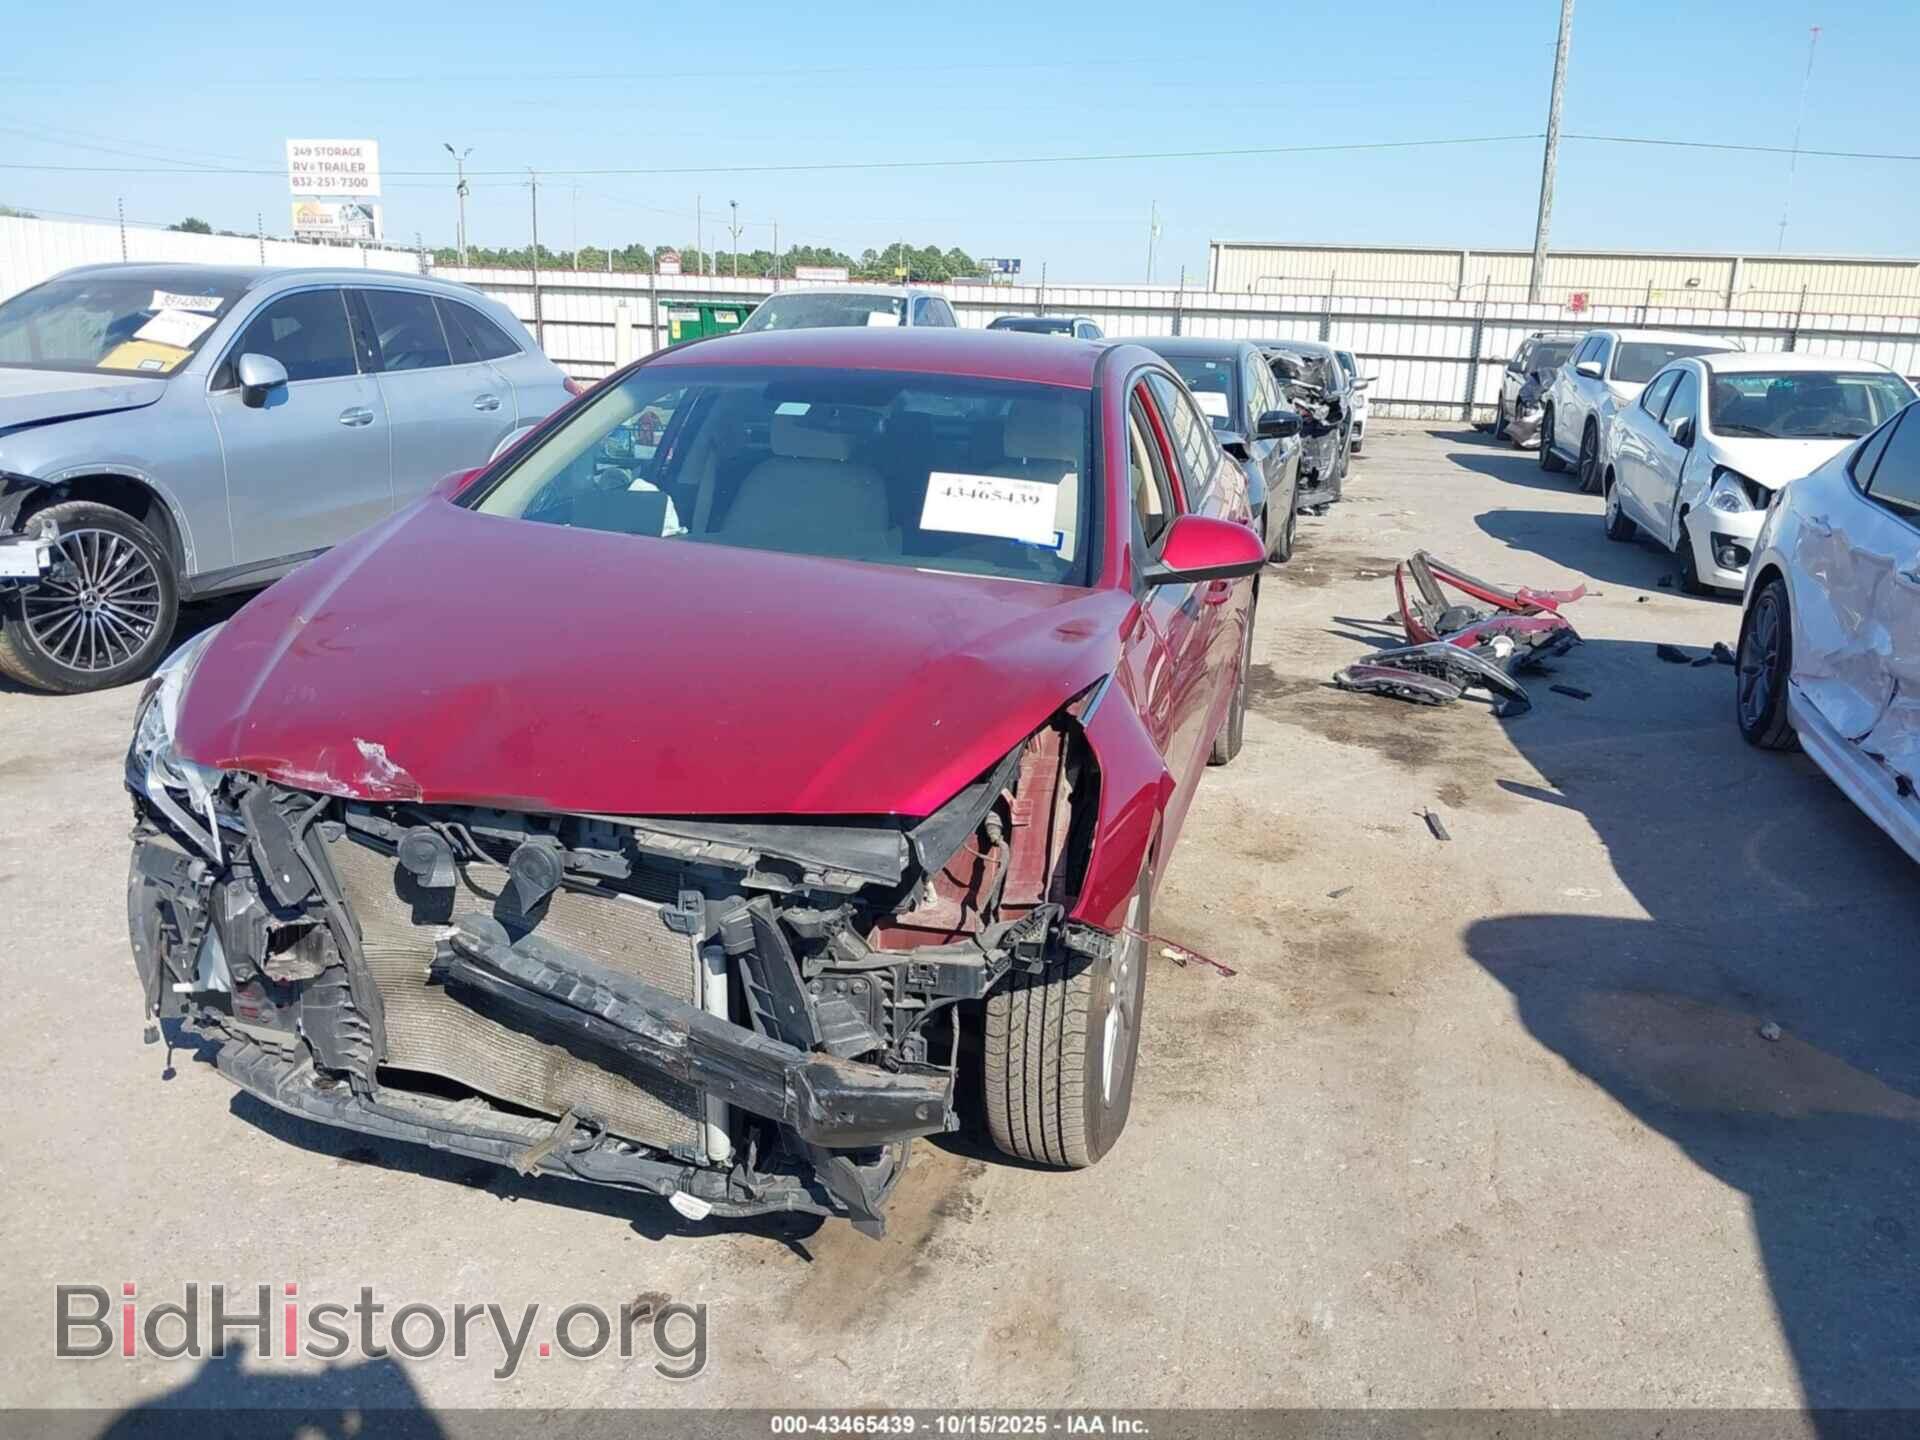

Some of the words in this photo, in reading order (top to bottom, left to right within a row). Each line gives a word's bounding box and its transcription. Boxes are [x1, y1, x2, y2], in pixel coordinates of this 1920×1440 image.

[293, 146, 312, 156] 249
[314, 146, 362, 157] STORAGE
[293, 160, 308, 171] RV
[318, 161, 366, 173] TRAILER
[939, 485, 1041, 505] 43465439
